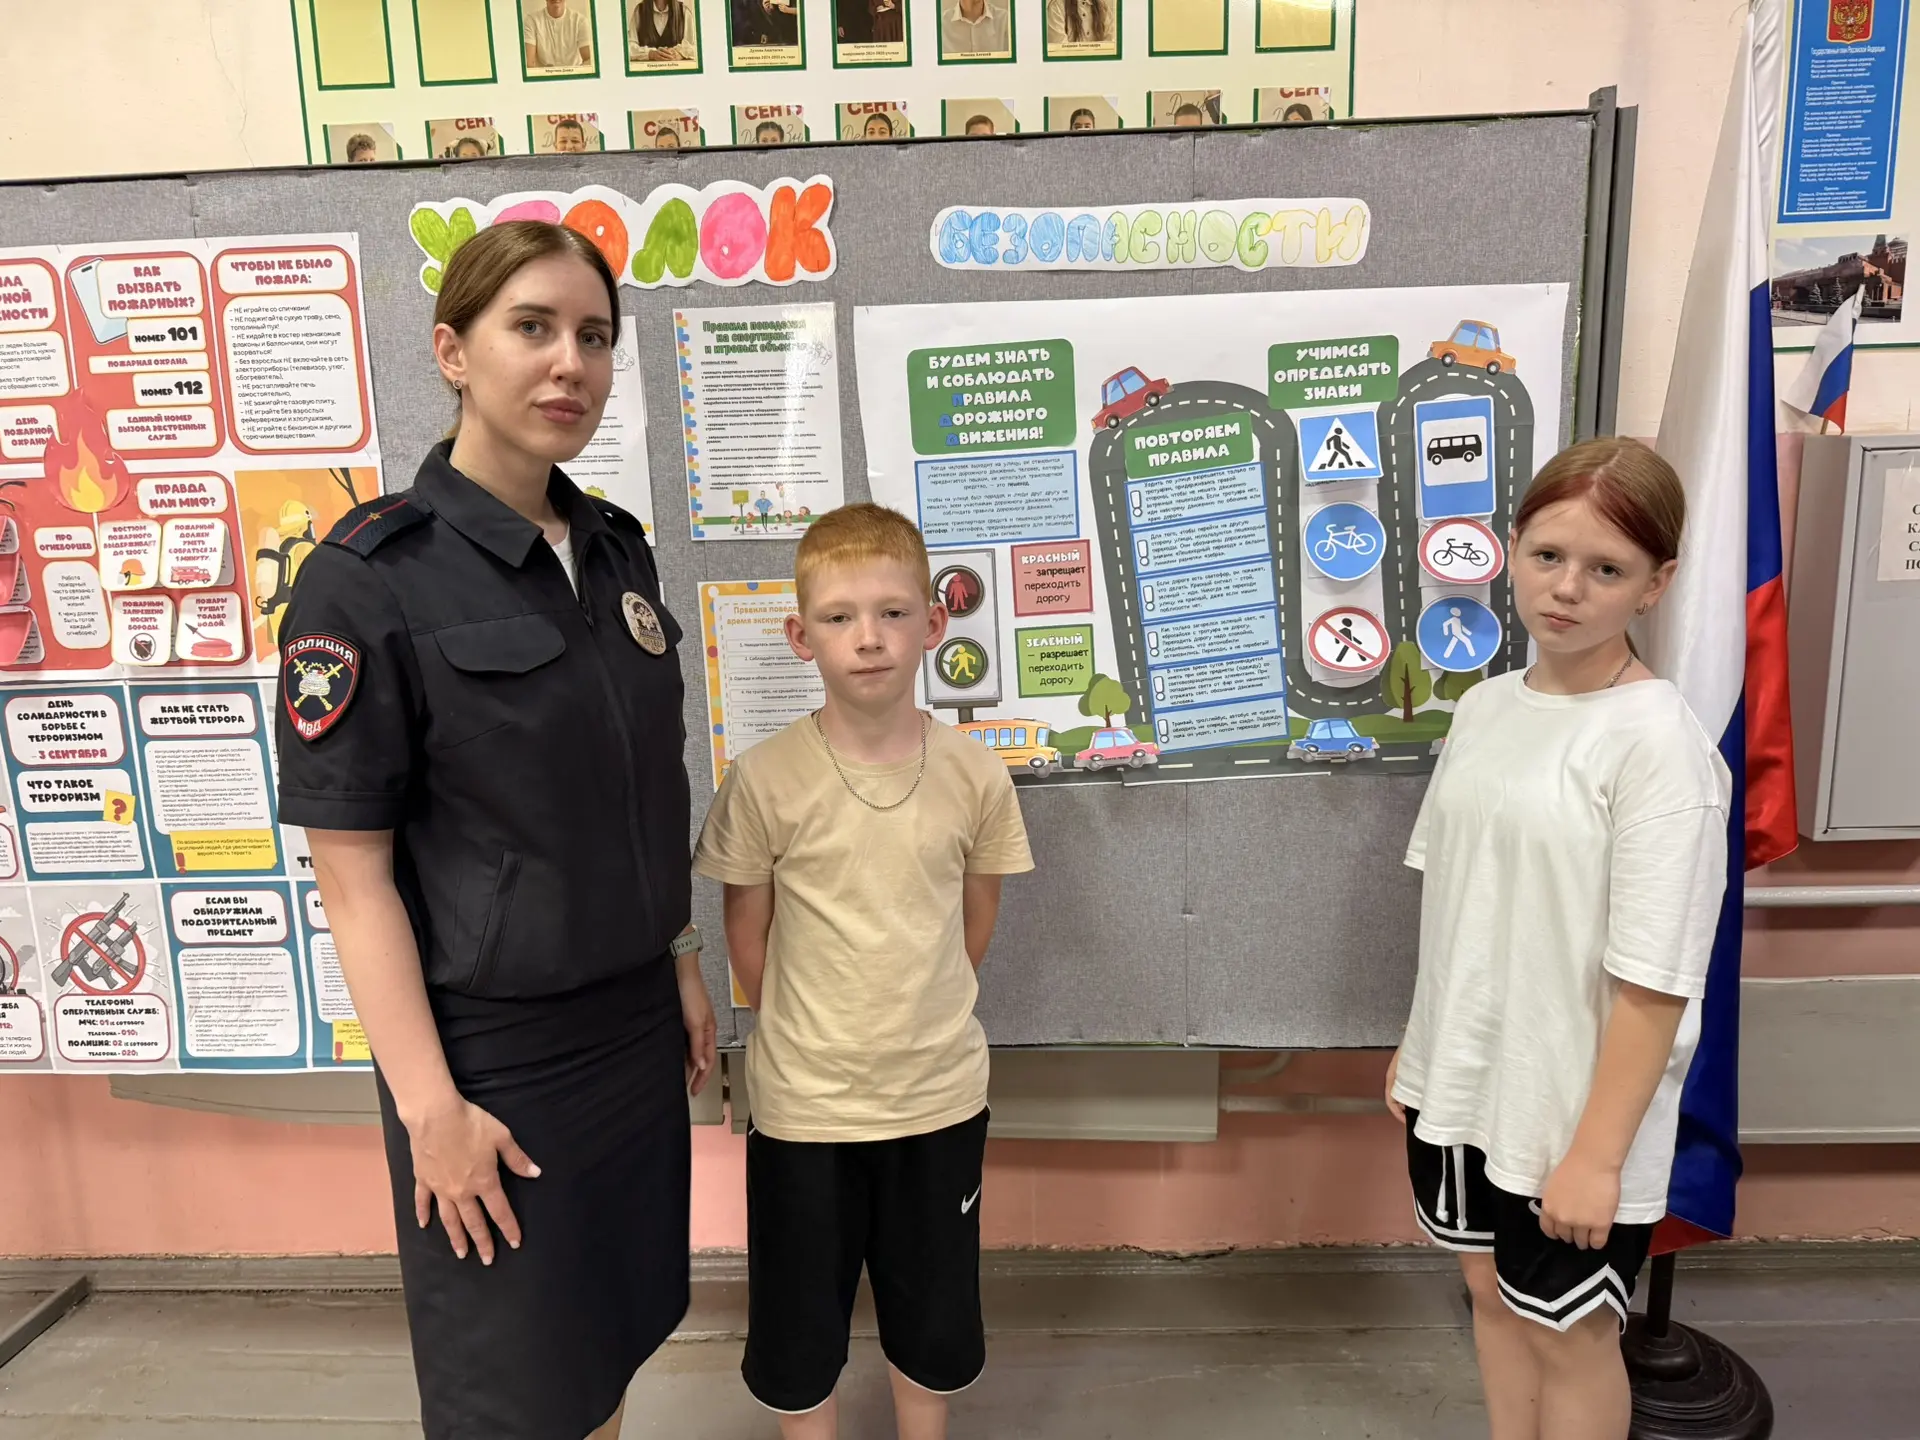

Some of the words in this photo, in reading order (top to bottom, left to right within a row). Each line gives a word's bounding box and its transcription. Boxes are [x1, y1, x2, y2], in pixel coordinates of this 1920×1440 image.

[938, 205, 1365, 267] БЕЗОПАСНОСТИ
[230, 261, 275, 271] ЧТОБЫ
[278, 260, 294, 270] НЕ
[295, 258, 333, 269] БЫЛО
[133, 265, 161, 277] КАК
[255, 274, 312, 286] ПОЖАРА:
[117, 281, 182, 295] ВЫЗВАТЬ
[108, 296, 195, 311] ПОЖАРНЫХ?
[702, 320, 748, 333] Правила
[135, 334, 166, 343] НОМЕР
[167, 326, 198, 341] 101
[715, 333, 729, 343] на
[704, 345, 712, 354] и
[713, 343, 758, 355] игровых
[1296, 343, 1370, 361] УЧИМСЯ
[108, 359, 152, 367] ПОЖАРНАЯ
[928, 352, 991, 369] БУДЕМ
[994, 348, 1050, 365] ЗНАТЬ
[926, 376, 939, 389] И
[942, 367, 1055, 388] СОБЛЮДАТЬ
[1274, 361, 1391, 383] ОПРЕДЕЛЯТЬ
[141, 388, 173, 397] НОМЕР
[174, 381, 203, 395] 112
[1304, 383, 1363, 401] ЗНАКИ
[952, 389, 1032, 407] ПРАВИЛА
[16, 417, 38, 425] ДЕНЬ
[127, 413, 163, 423] ЕДИНЫЙ
[938, 407, 1048, 428] ДОРОЖНОГО
[4, 425, 53, 436] ПОЖАРНОЙ
[118, 425, 151, 433] ВЫЗОВА
[153, 423, 207, 431] ЭКСТРЕННЫХ
[945, 426, 1044, 446] ДВИЖЕНИЯ!
[1134, 422, 1240, 450] ПОВТОРЯЕМ
[1148, 443, 1230, 467] ПРАВИЛА
[155, 483, 206, 494] ПРАВДА
[149, 498, 176, 509] ИЛИ
[179, 497, 216, 508] МИФ?
[175, 522, 215, 530] ПОЖАРНЫЙ
[108, 532, 152, 540] ПОЖАРНОГО
[39, 543, 92, 551] ОГНЕБОРЦЕВ
[1021, 549, 1081, 565] КРАСНЫЙ
[1036, 566, 1086, 578] запрещает
[1024, 579, 1081, 592] переходить
[1036, 593, 1071, 605] дорогу
[733, 606, 768, 614] Правила
[769, 605, 798, 613] поведе
[1026, 632, 1083, 647] ЗЕЛЁНЫЙ
[288, 638, 354, 665] ПОЛИЦИЯ
[1040, 649, 1089, 662] разрешает
[1029, 662, 1085, 674] переходить
[1040, 676, 1074, 687] дорогу
[47, 700, 74, 709] ДЕНЬ
[160, 705, 181, 713] КАК
[182, 705, 195, 713] НЕ
[197, 704, 230, 713] СТАТЬ
[17, 710, 99, 720] СОЛИДАРНОСТИ
[101, 710, 107, 718] В
[150, 714, 197, 725] ЖЕРТВОЙ
[198, 715, 245, 724] ТЕРРОРА
[42, 722, 78, 731] БОРЬБЕ
[80, 722, 86, 730] С
[297, 717, 322, 736] МВД
[28, 733, 103, 742] ТЕРРОРИЗМОМ
[38, 750, 46, 760] 3
[48, 748, 108, 759] СЕНТЯБРЯ
[27, 780, 52, 790] ЧТО
[54, 779, 94, 789] ТАКОЕ
[29, 792, 101, 803] ТЕРРОРИЗМ
[206, 897, 231, 905] ЕСЛИ
[182, 916, 277, 926] ПОДОЗРИТЕЛЬНЫЙ
[207, 929, 253, 937] ПРЕДМЕТ
[85, 998, 134, 1007] ТЕЛЕФОНЫ
[62, 1008, 125, 1016] ОПЕРАТИВНЫХ
[127, 1007, 160, 1015] СЛУЖБ:
[68, 1039, 111, 1047] ПОЛИЦИЯ:
